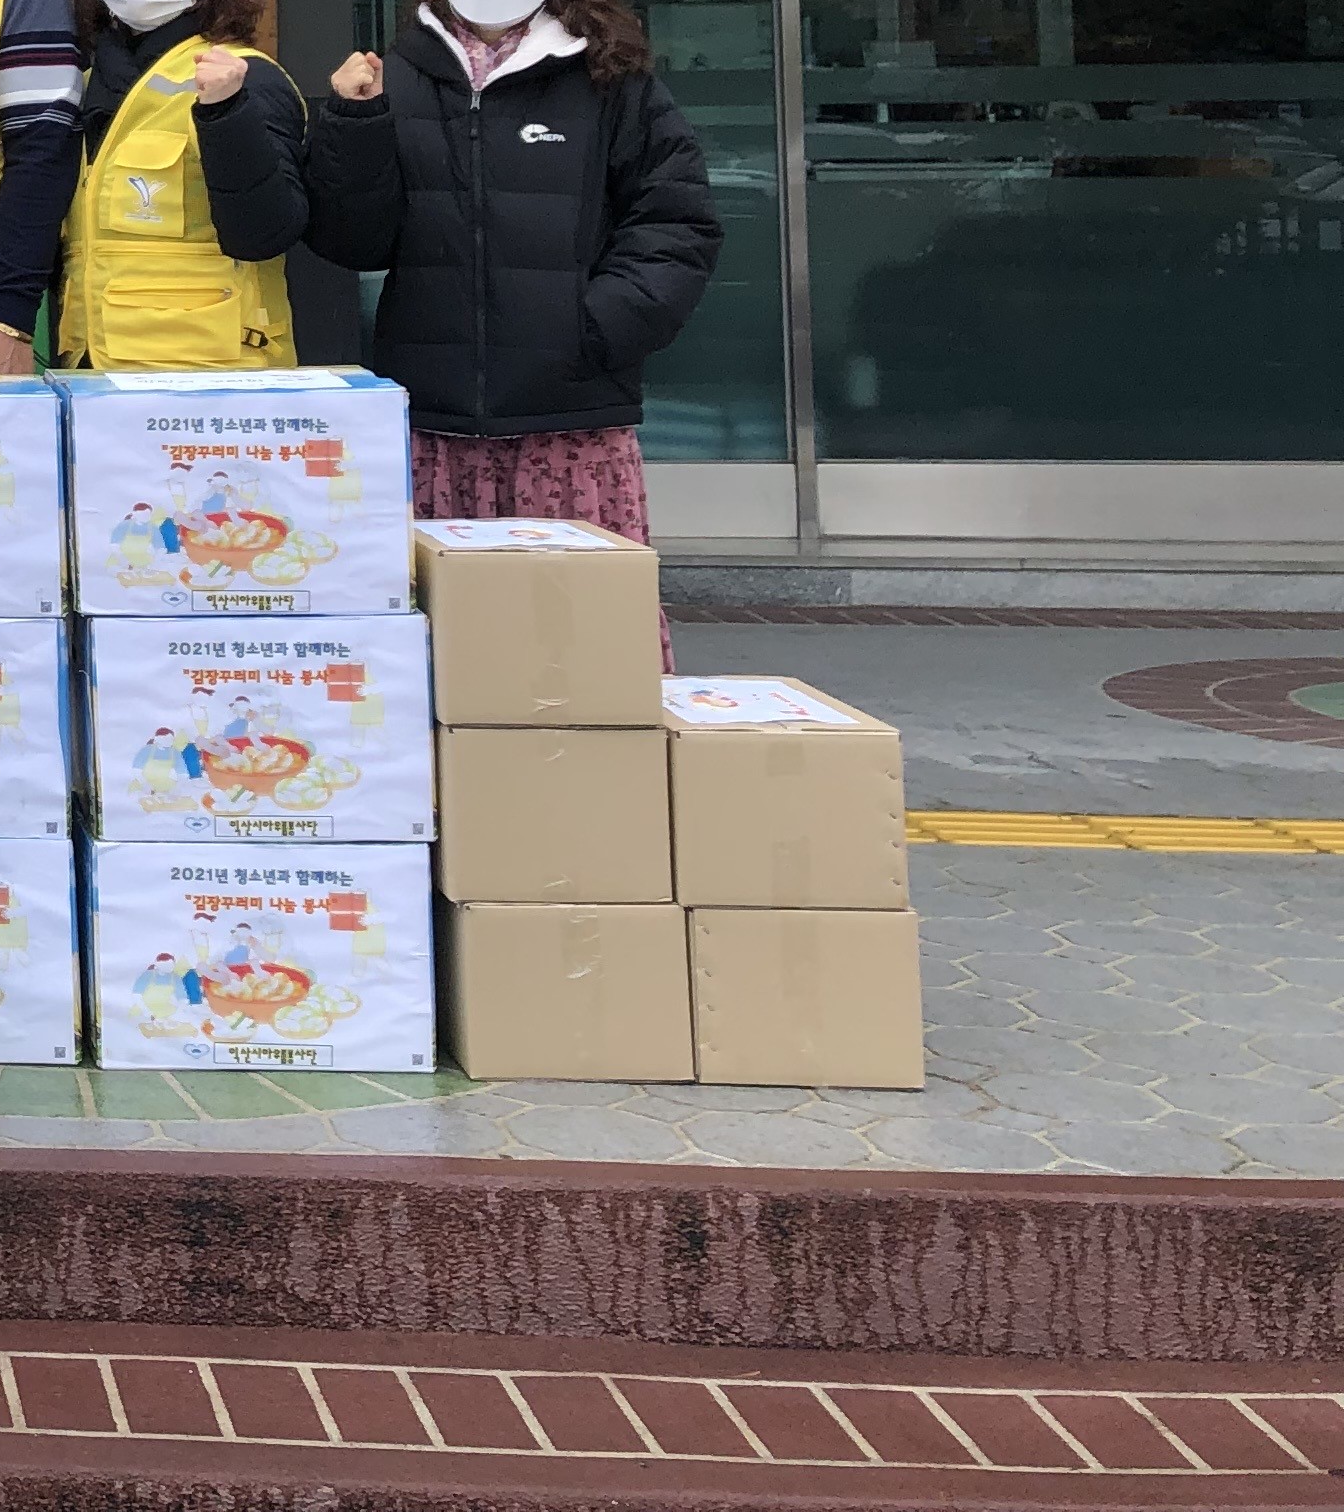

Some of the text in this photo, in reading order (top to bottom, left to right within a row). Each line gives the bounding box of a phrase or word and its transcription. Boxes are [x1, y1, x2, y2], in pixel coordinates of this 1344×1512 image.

[147, 417, 330, 434] 2021년 청소년과 함께하는
[245, 445, 274, 461] 나눔
[168, 641, 351, 658] 2021년 청소년과 함께하는
[266, 669, 295, 685] 나눔
[170, 866, 354, 887] 2021년 청소년과 함께하는
[269, 897, 297, 913] 나눔
